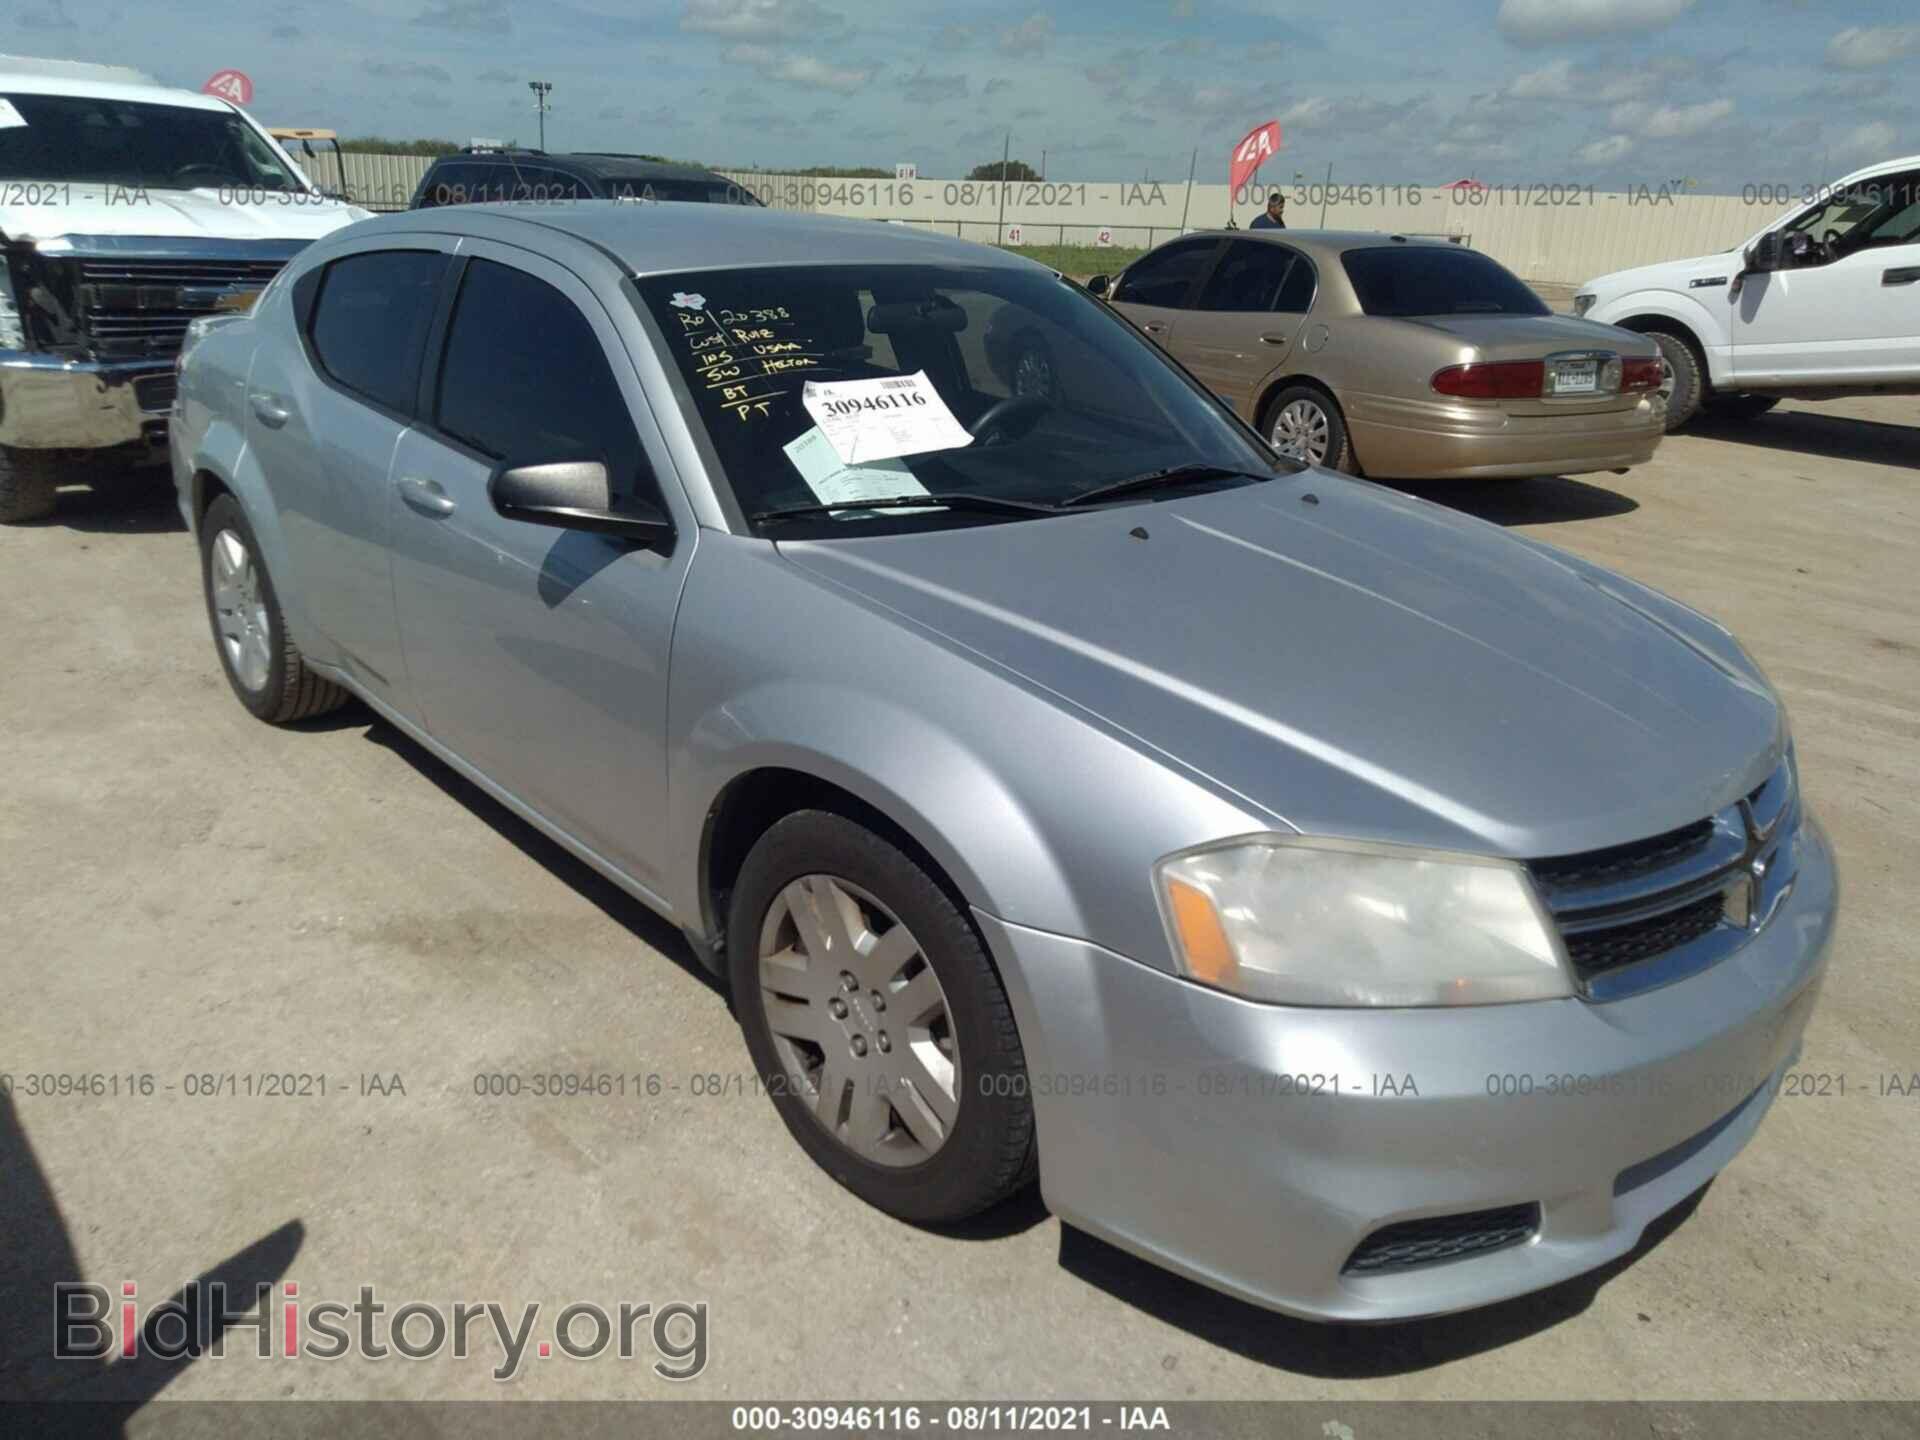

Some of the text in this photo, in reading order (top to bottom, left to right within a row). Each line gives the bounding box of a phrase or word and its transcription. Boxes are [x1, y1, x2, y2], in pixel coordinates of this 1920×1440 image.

[1009, 229, 1020, 241] 41
[1099, 231, 1110, 243] 42
[723, 385, 748, 400] BT
[821, 391, 927, 417] 30946116
